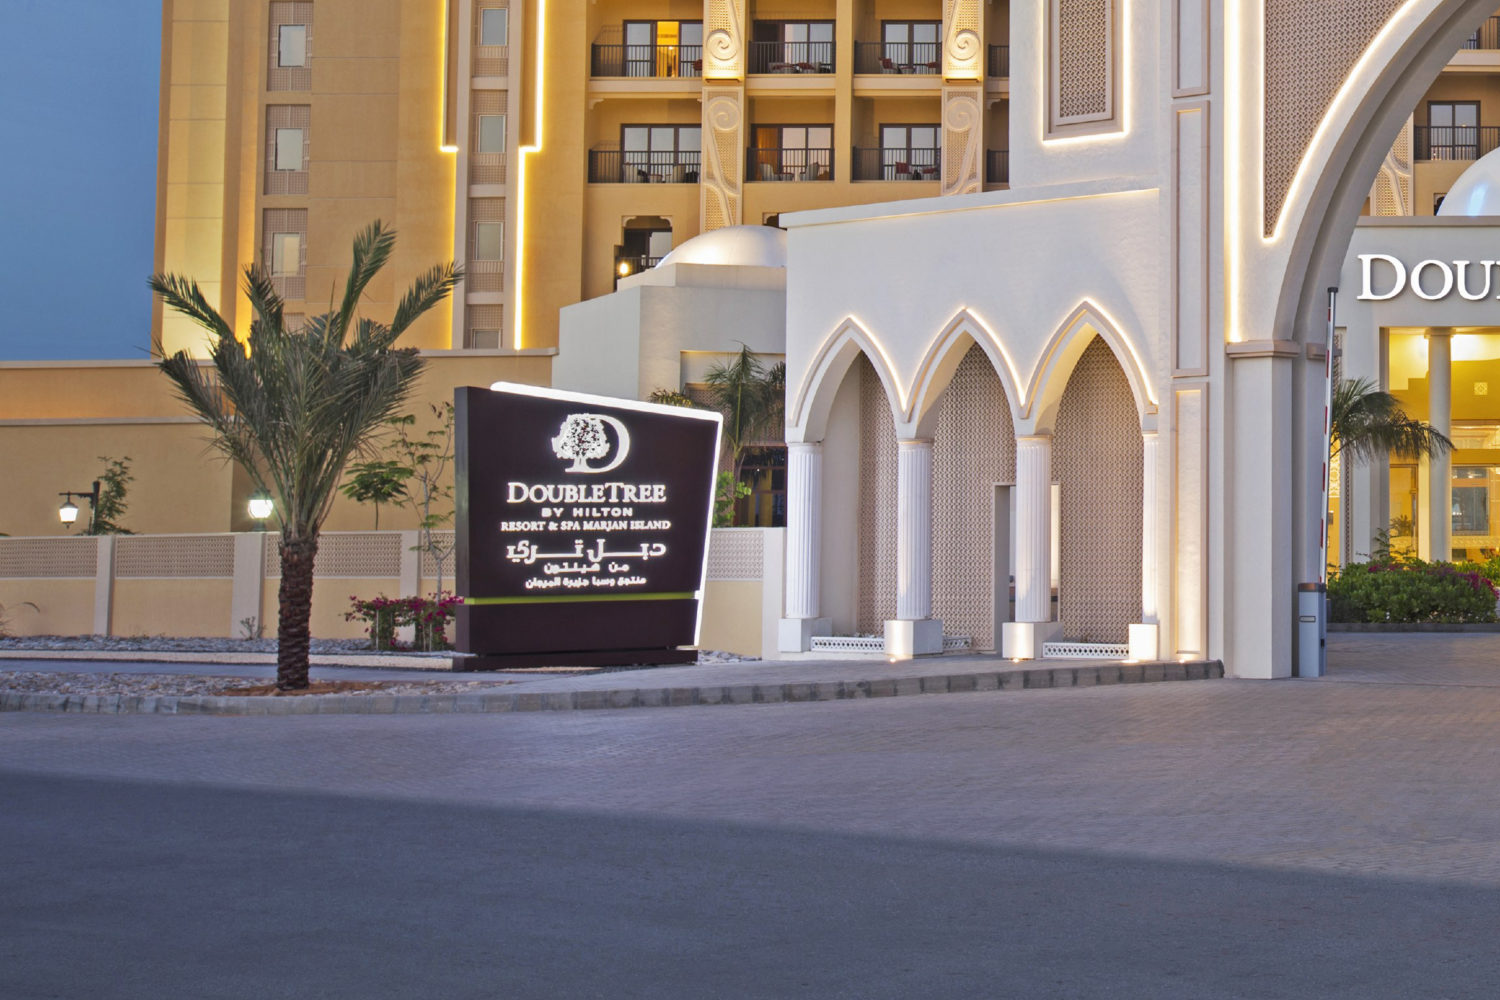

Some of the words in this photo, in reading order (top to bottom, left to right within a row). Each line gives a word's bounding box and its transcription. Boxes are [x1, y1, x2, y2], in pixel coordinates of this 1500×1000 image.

[541, 507, 564, 518] BY
[573, 507, 633, 518] HILTON
[500, 521, 546, 532] RESORT
[547, 521, 559, 531] &
[561, 521, 581, 531] SPA
[583, 520, 628, 533] MARJAN
[630, 520, 672, 531] ISLAND
[587, 538, 667, 563] دبل
[543, 561, 601, 575] هيلتون
[608, 561, 630, 573] من
